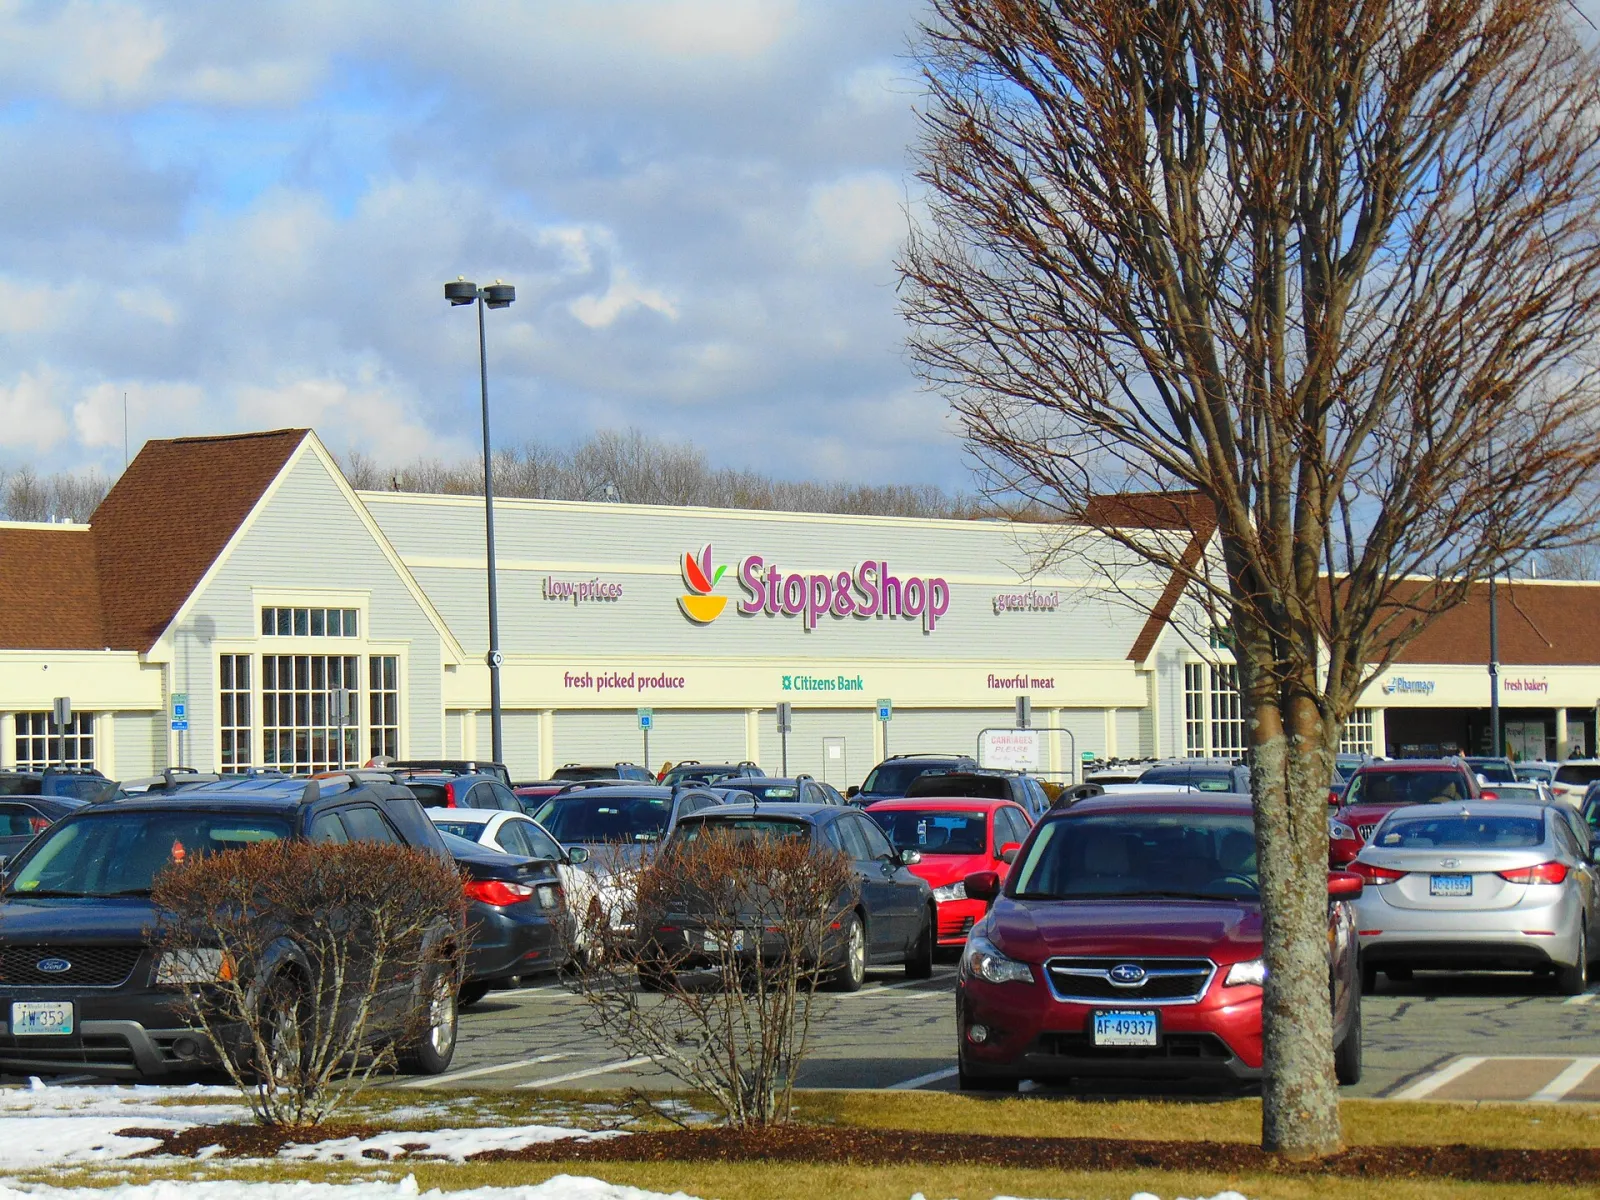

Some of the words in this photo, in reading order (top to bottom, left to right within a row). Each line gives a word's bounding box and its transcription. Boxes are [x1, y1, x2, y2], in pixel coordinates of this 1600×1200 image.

[547, 575, 575, 596] low
[579, 576, 623, 602] prices
[739, 555, 950, 631] Stop&Shop
[997, 593, 1029, 612] great
[1032, 590, 1059, 607] food
[563, 671, 593, 688] fresh
[596, 671, 635, 693] picked
[637, 672, 685, 693] produce
[793, 675, 836, 691] Citizens
[837, 674, 864, 691] Bank
[987, 673, 1029, 689] flavorful
[1030, 677, 1055, 689] meat
[1397, 677, 1436, 695] Pharmacy
[1504, 678, 1523, 691] fresh
[1524, 678, 1549, 694] bakery
[994, 745, 1029, 753] PLEASE
[43, 961, 63, 970] Ford
